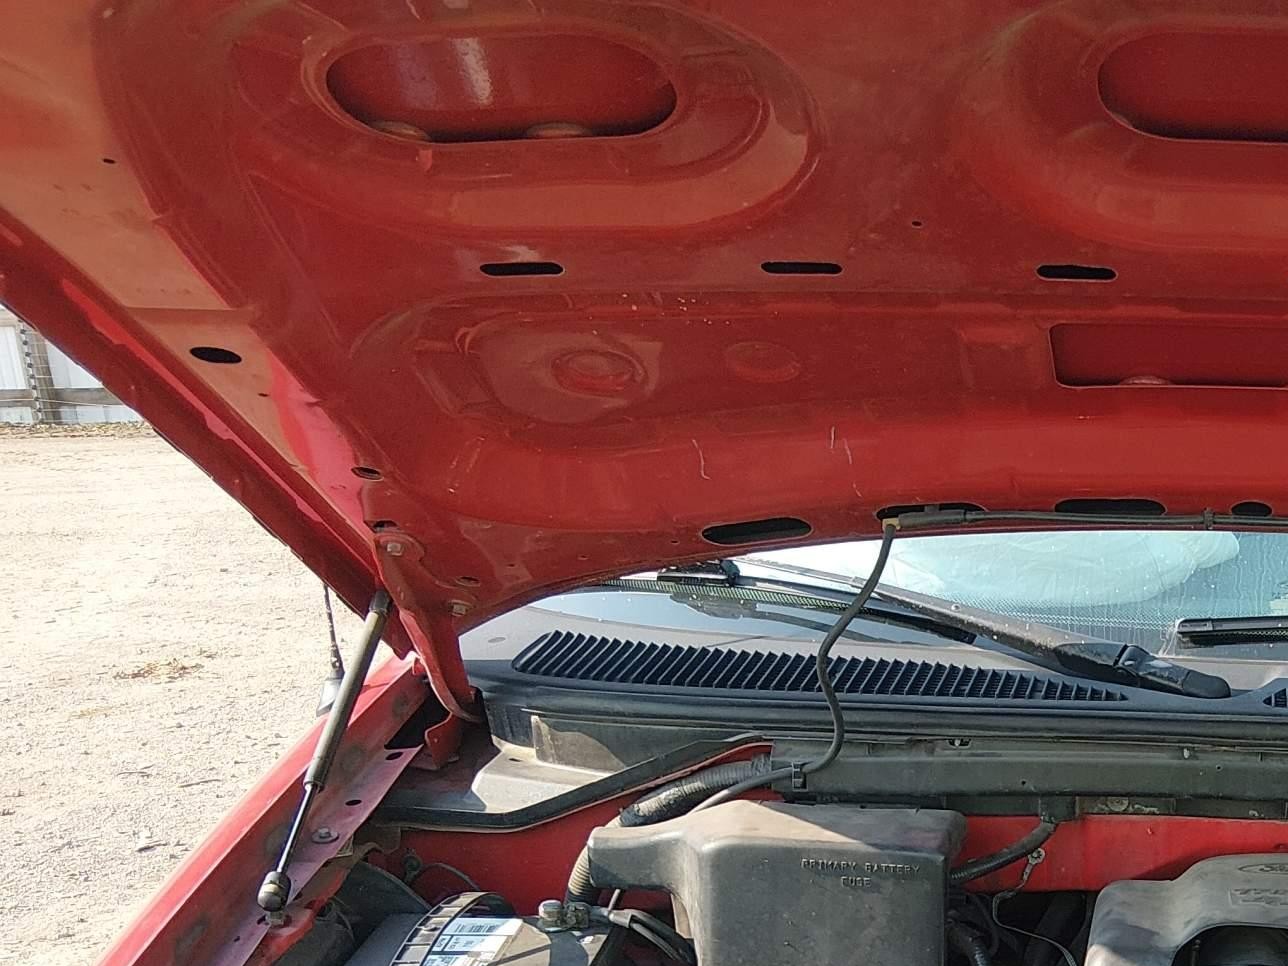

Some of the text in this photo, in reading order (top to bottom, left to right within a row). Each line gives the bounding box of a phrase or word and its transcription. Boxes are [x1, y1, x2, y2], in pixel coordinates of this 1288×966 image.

[800, 858, 921, 874] PRIMARY BATTERY
[841, 876, 873, 888] FUSE
